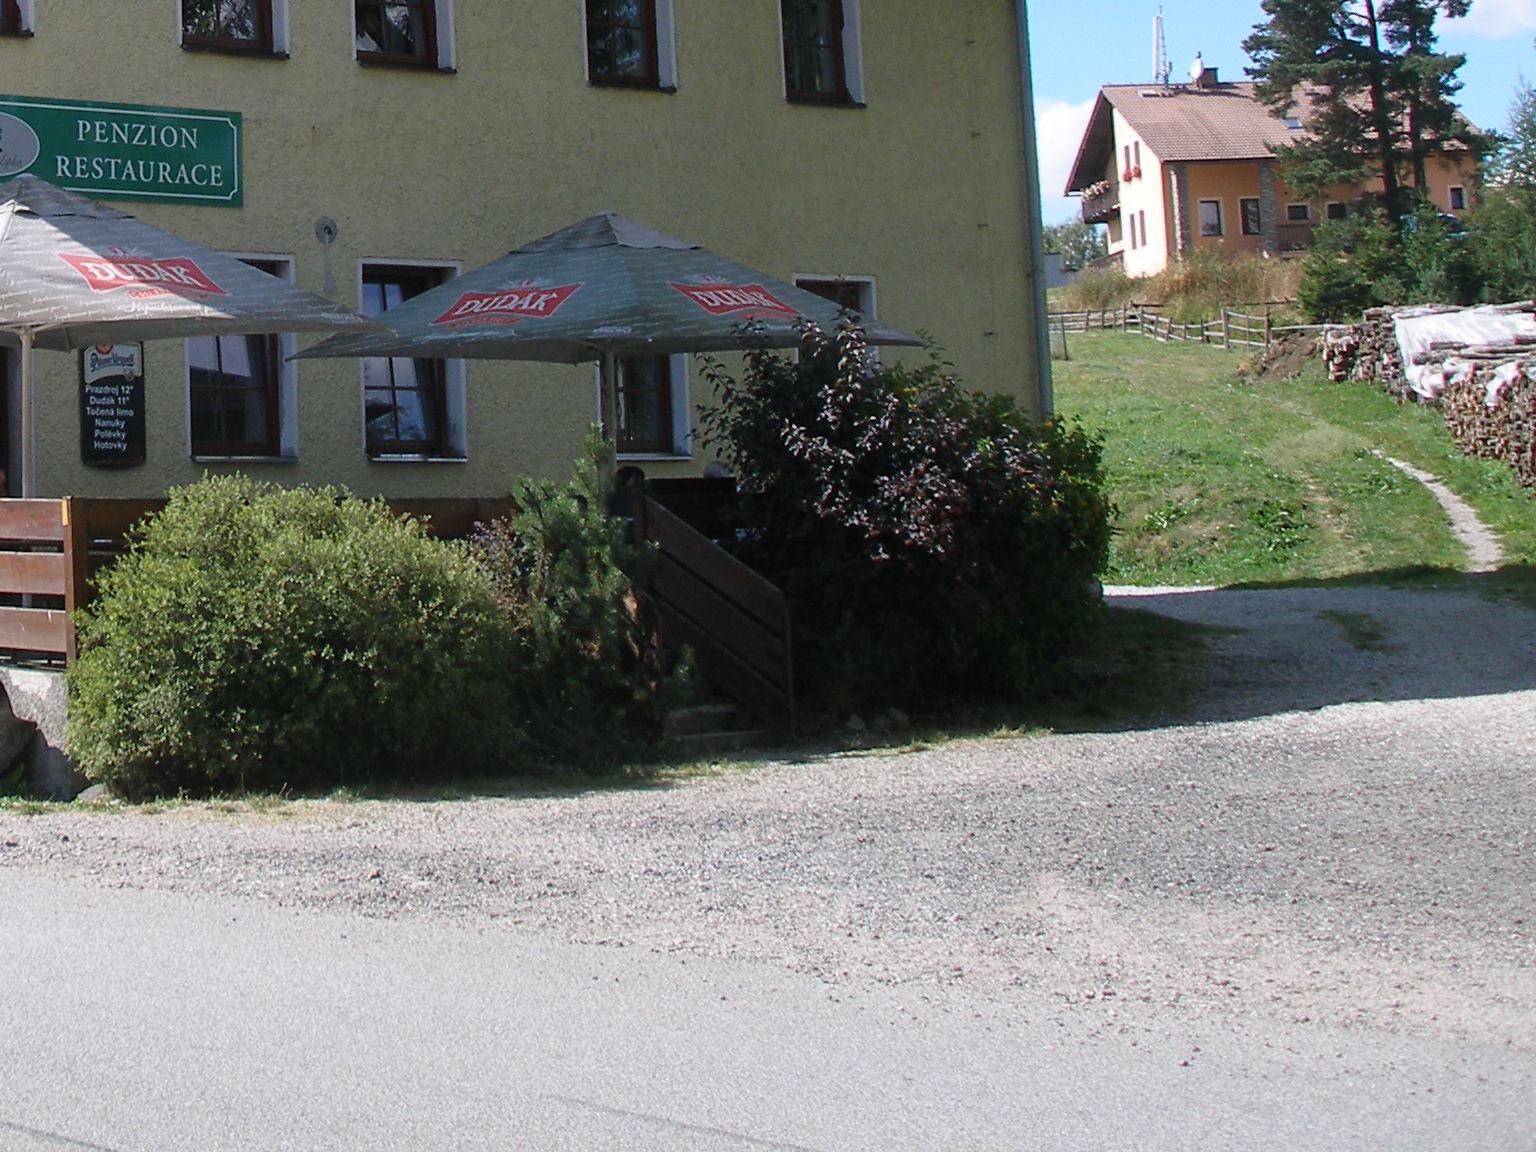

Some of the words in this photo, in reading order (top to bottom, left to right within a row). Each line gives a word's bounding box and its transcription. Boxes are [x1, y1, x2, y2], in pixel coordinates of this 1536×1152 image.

[77, 119, 198, 149] PENZION
[55, 155, 224, 187] RESTAURACE
[80, 260, 208, 289] DUDÁK
[452, 291, 559, 316] DUDÁK
[85, 384, 119, 396] Prazdroj
[95, 418, 125, 429] Nanuky
